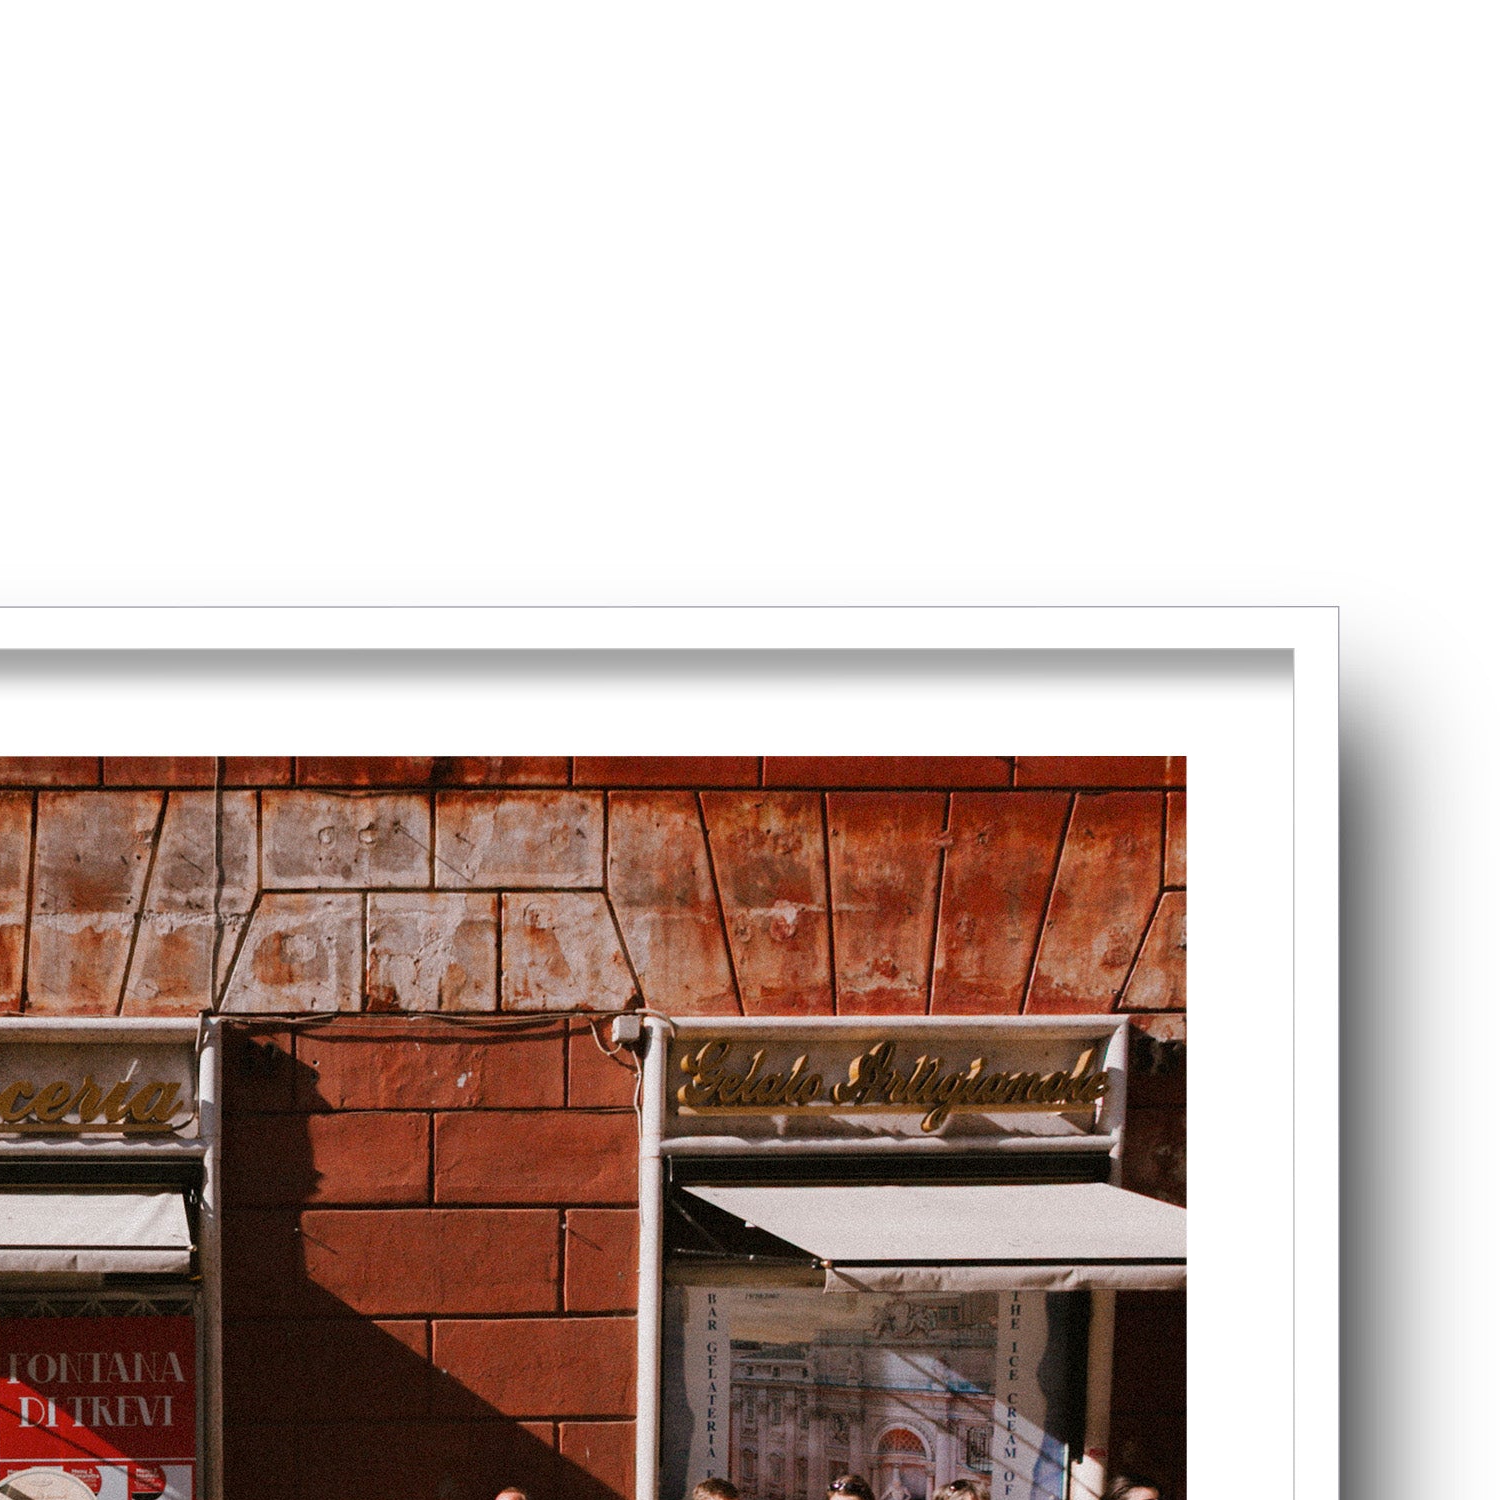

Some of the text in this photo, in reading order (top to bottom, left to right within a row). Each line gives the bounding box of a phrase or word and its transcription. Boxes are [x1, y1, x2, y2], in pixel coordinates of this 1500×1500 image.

[677, 1038, 1110, 1133] Gelato Artigianale
[707, 1293, 717, 1330] BAR
[1010, 1290, 1021, 1330] THE
[6, 1352, 186, 1384] FONTANA
[1009, 1342, 1020, 1381] ICE
[18, 1395, 174, 1428] DI TREVI
[707, 1342, 717, 1458] GELATERIA
[1004, 1393, 1018, 1459] CREAM
[1003, 1471, 1016, 1496] OF
